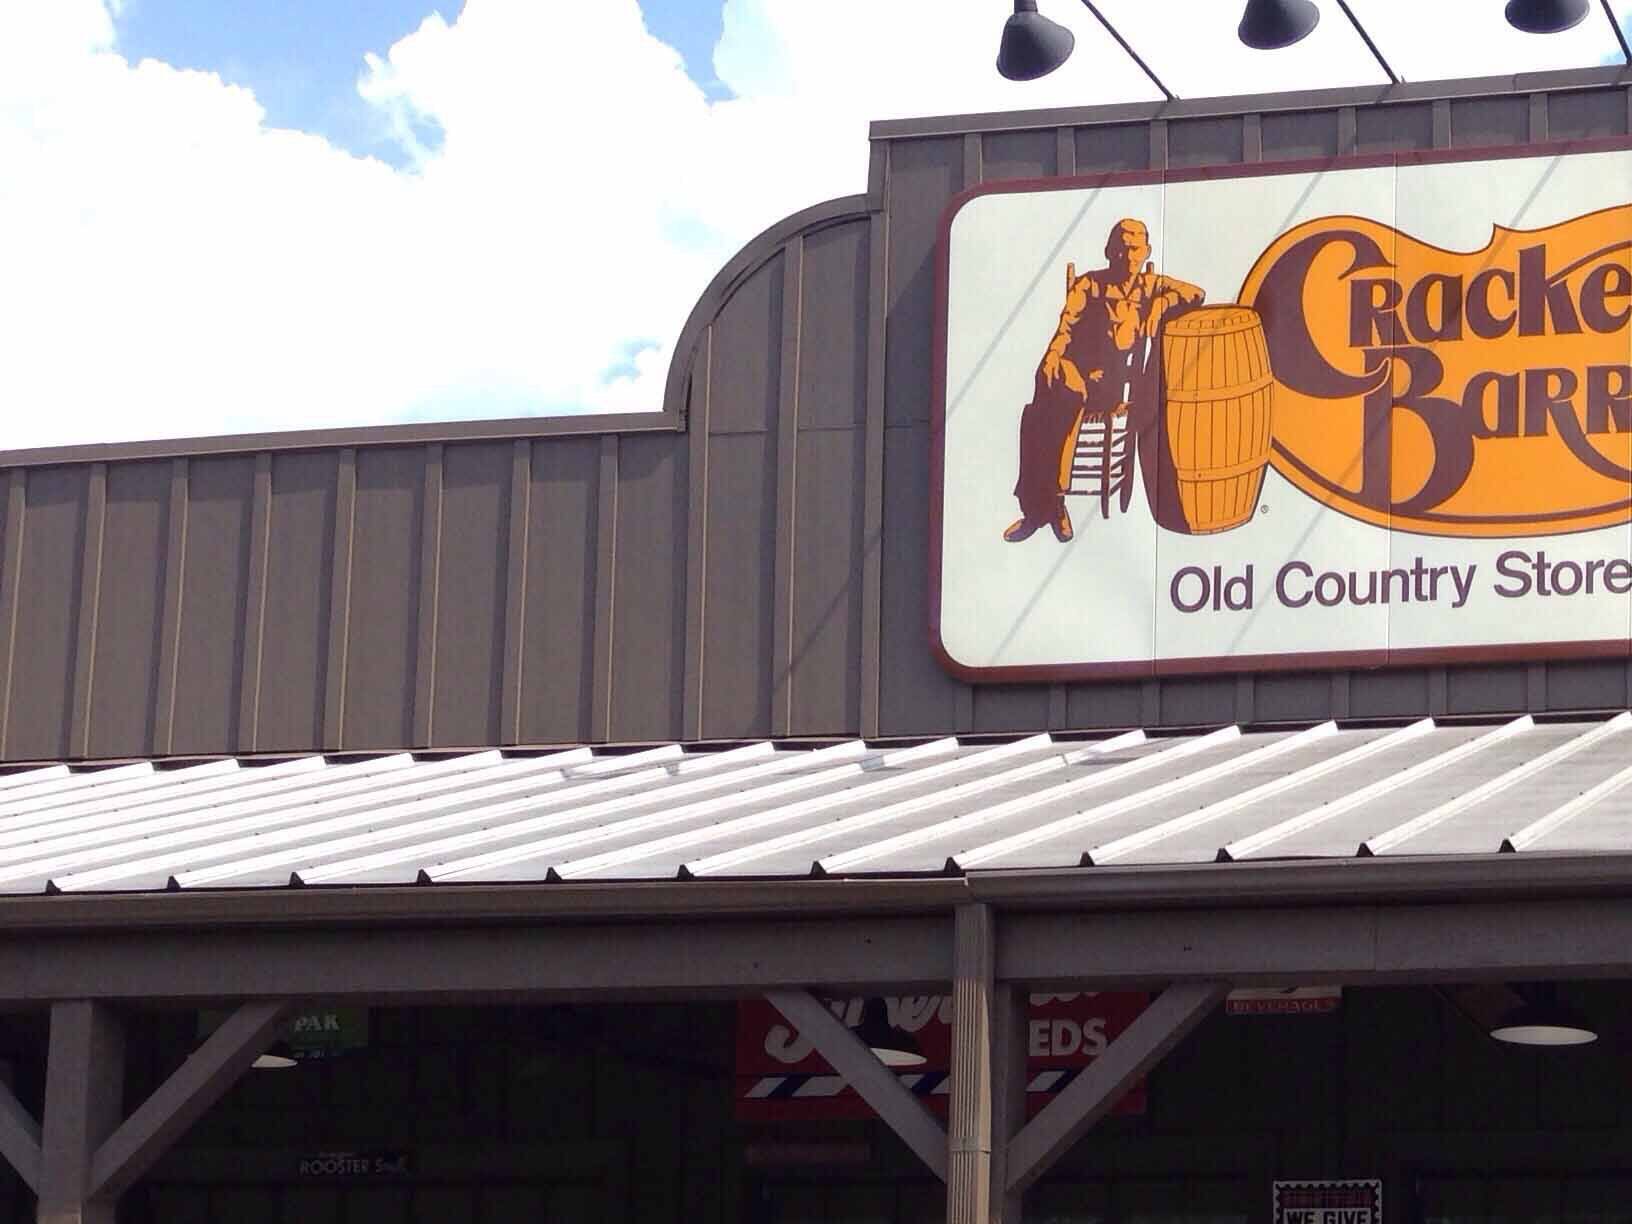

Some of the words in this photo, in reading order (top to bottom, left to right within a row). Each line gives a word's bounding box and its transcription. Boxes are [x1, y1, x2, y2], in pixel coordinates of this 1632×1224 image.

[1169, 565, 1255, 614] Old
[1275, 555, 1478, 611] Country
[1028, 1018, 1108, 1057] EDS
[299, 1158, 369, 1176] ROOSTER
